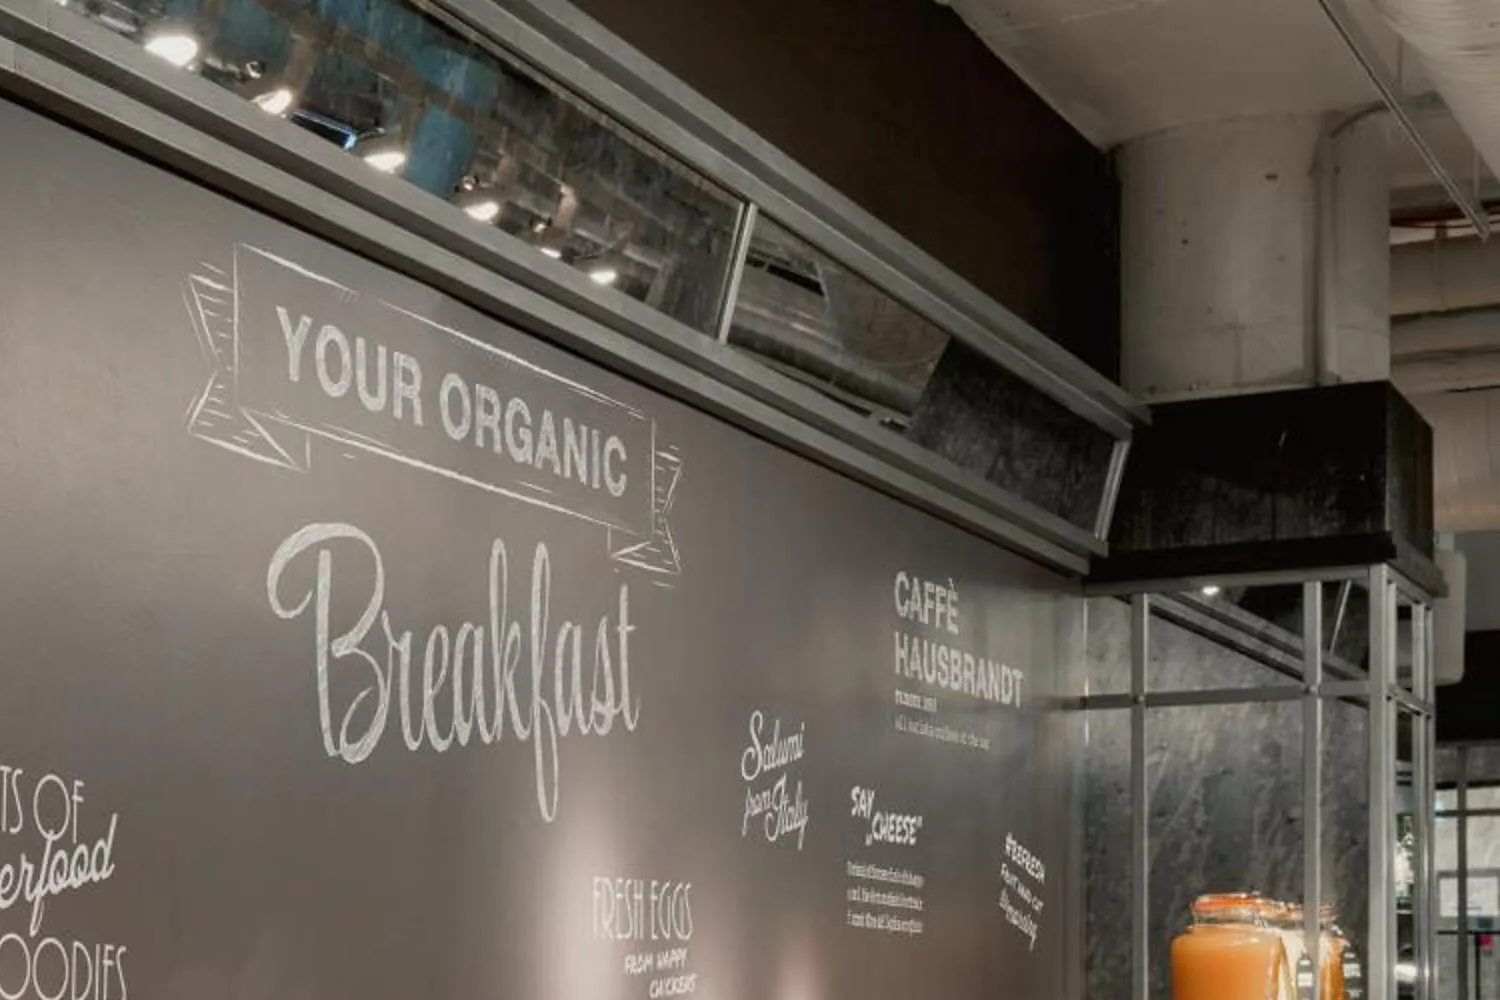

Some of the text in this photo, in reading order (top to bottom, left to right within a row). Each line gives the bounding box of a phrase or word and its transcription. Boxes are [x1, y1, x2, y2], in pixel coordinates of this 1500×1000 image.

[276, 304, 628, 498] YOUR ORGANIC
[267, 522, 639, 822] Breakfast
[894, 631, 1024, 708] HAUSBRANDT
[33, 774, 85, 844] OF
[851, 786, 875, 820] SAY
[592, 877, 693, 940] FRESH EGGS
[625, 953, 654, 975] FROM
